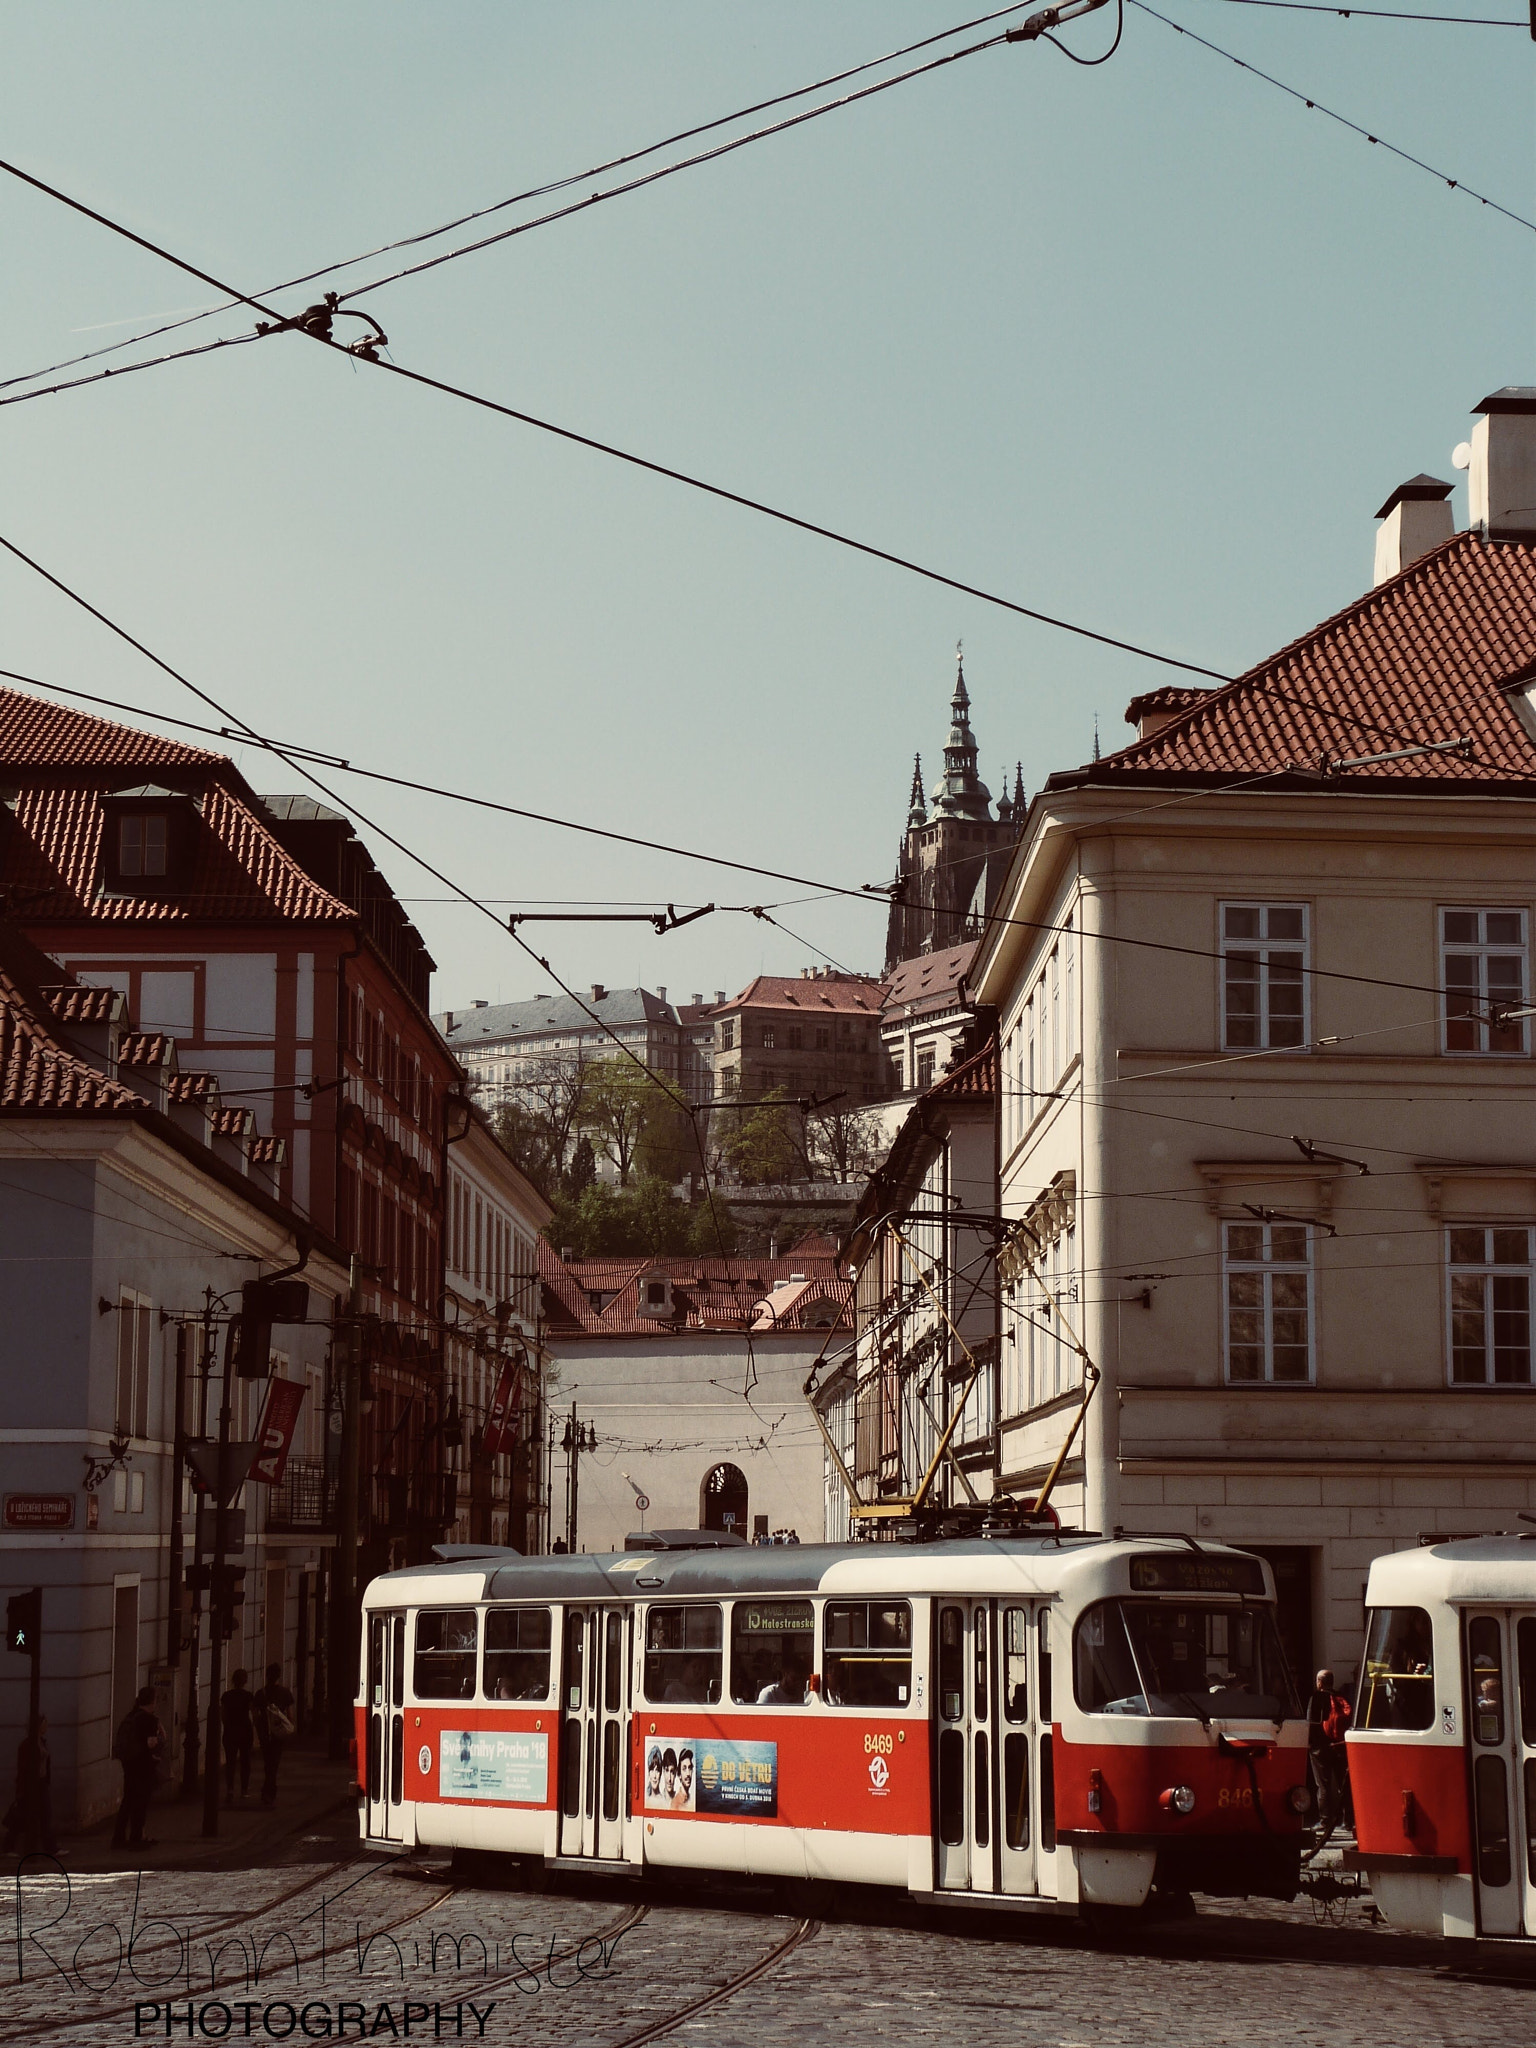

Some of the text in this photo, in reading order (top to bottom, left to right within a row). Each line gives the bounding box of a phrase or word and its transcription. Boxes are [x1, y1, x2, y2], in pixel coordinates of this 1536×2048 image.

[442, 1738, 463, 1756] Svě
[496, 1740, 529, 1759] Praha
[864, 1733, 893, 1754] 8469
[721, 1758, 772, 1783] DO VĚTRU
